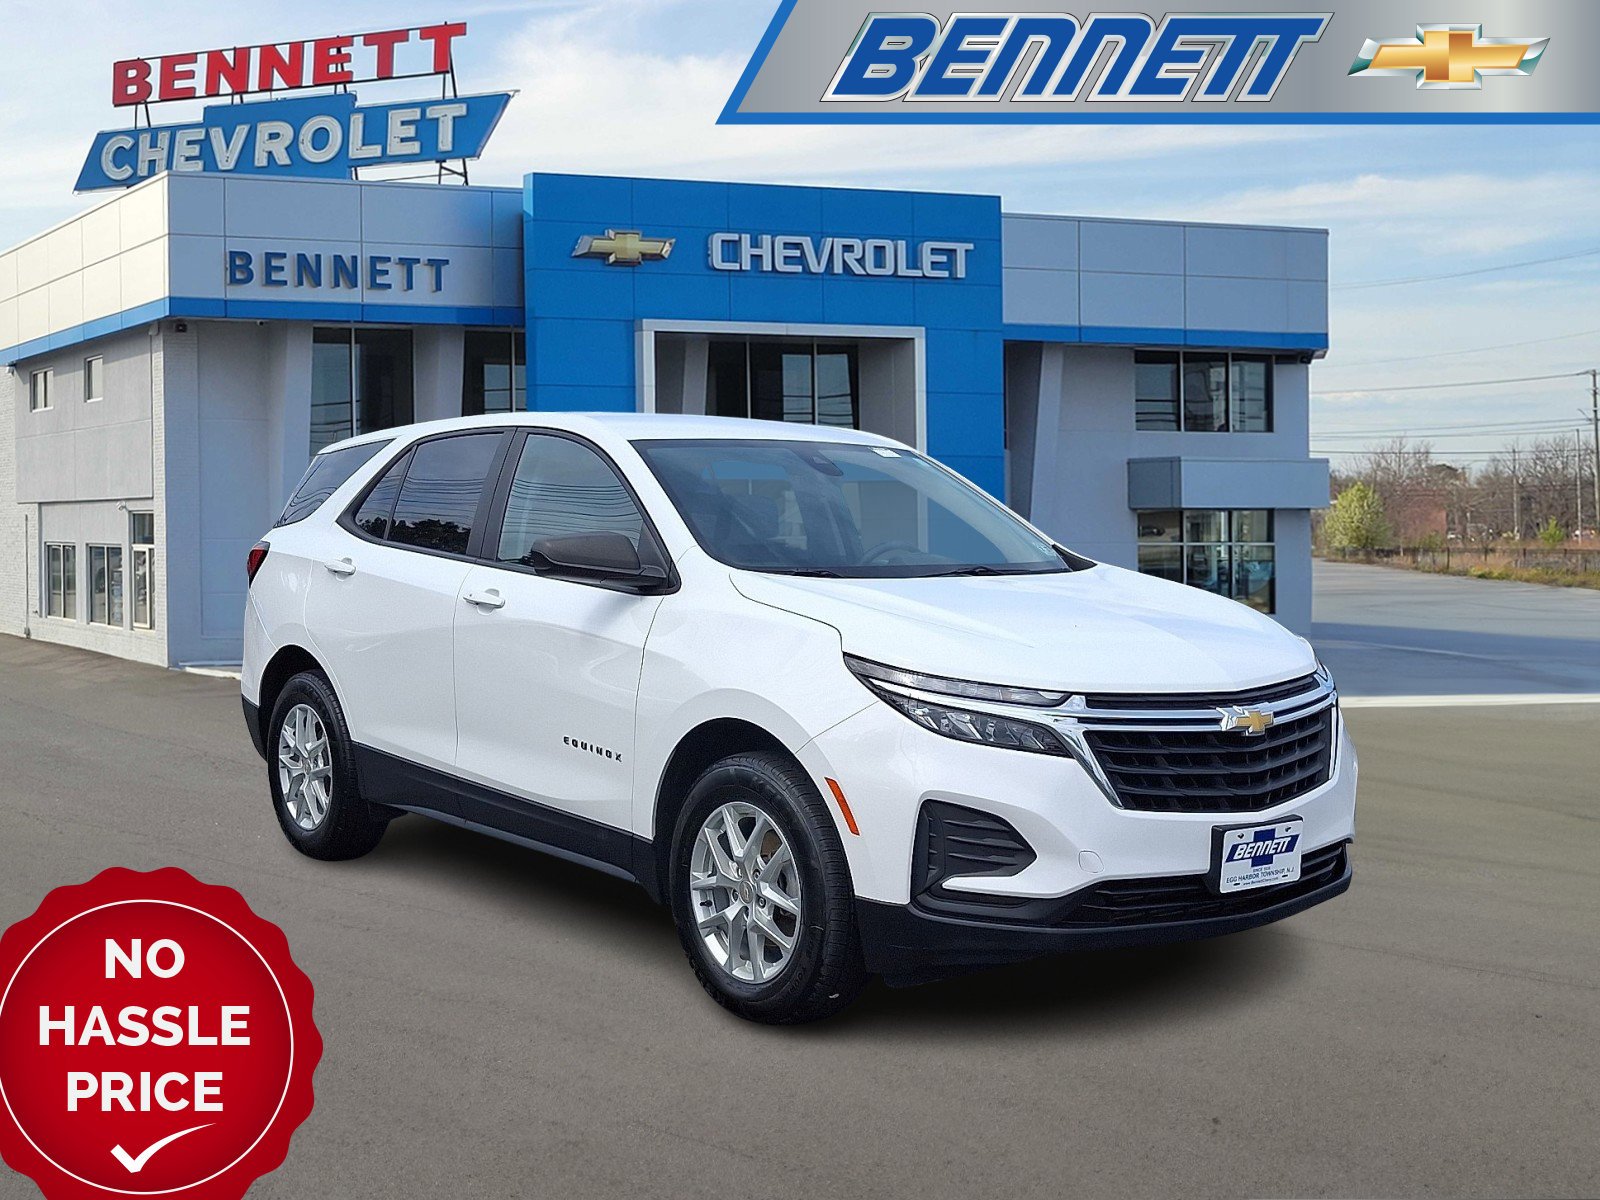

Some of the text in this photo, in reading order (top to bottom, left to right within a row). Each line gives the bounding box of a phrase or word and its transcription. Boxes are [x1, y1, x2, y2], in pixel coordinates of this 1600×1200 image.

[112, 22, 467, 107] BENNETT
[100, 103, 467, 181] CHEVROLET
[226, 249, 450, 293] BENNETT
[708, 232, 974, 279] CHEVROLET
[563, 736, 623, 763] EQUINOX
[1233, 837, 1291, 860] BENNETT
[1238, 873, 1260, 881] HARBOR
